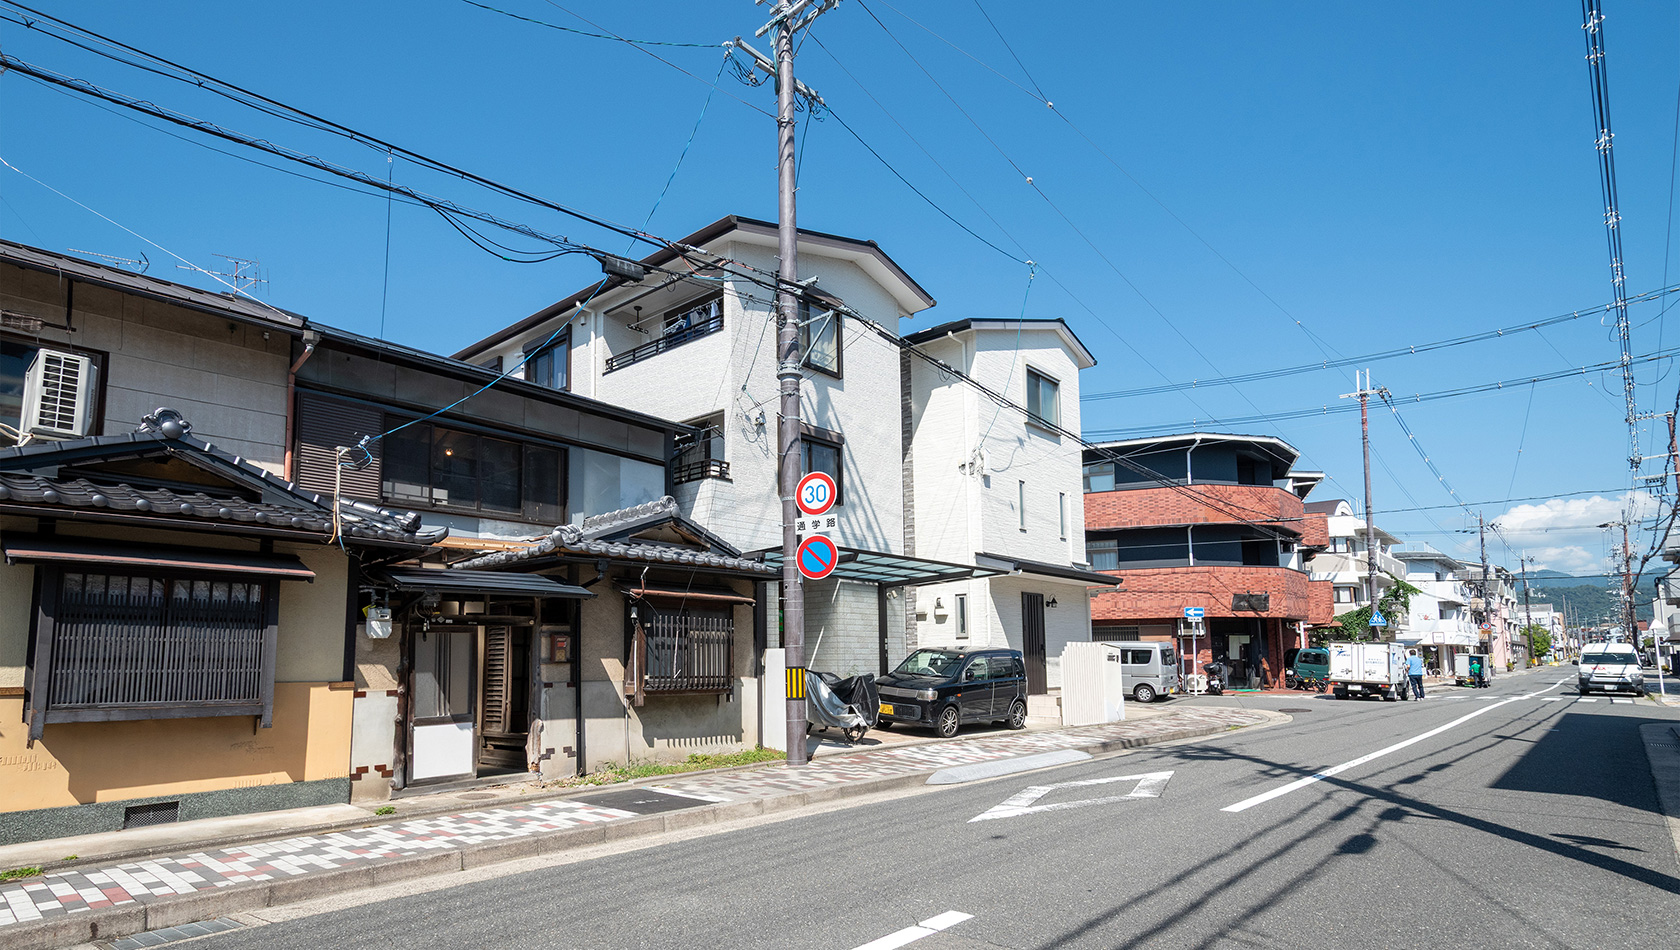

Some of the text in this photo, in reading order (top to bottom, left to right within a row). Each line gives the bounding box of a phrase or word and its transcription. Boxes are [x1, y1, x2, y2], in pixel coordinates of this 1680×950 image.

[805, 484, 827, 504] 30
[797, 518, 835, 531] 通学路
